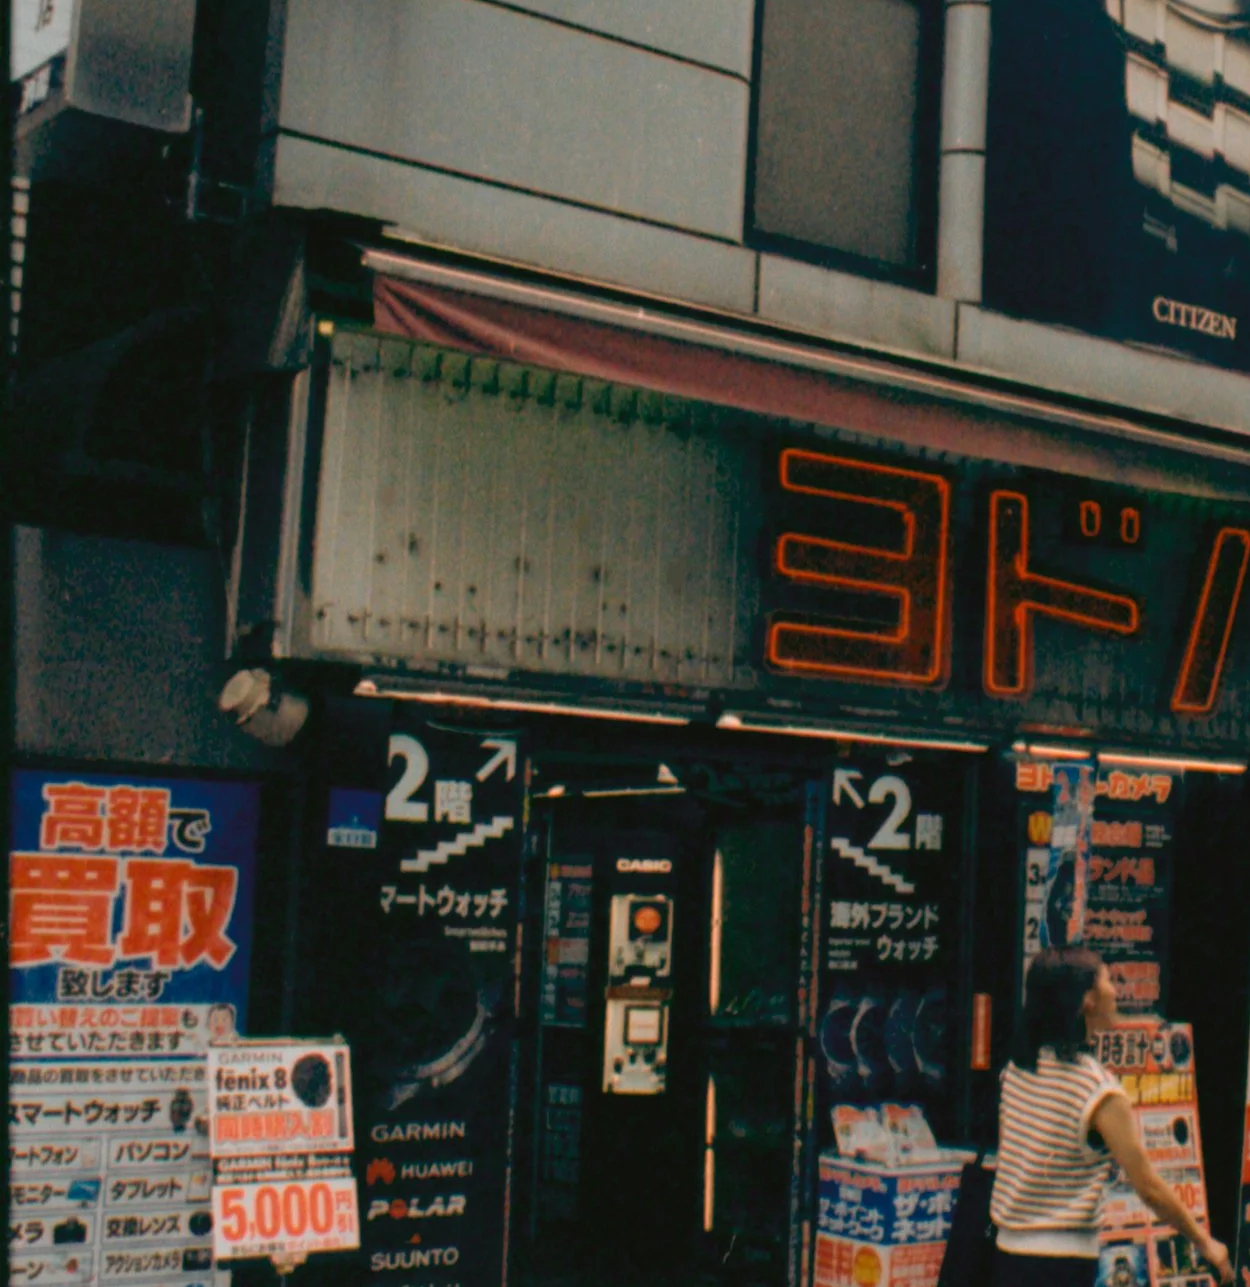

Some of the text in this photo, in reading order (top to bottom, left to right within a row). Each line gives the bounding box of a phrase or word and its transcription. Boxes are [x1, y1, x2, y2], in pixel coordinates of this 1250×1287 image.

[1152, 296, 1237, 340] CITIZEN
[384, 734, 472, 824] 2階
[40, 781, 212, 854] 高額で
[866, 776, 942, 850] 2階
[616, 857, 673, 873] CASIO
[9, 852, 239, 972] 買取
[876, 934, 940, 961] ウォッチ
[59, 966, 170, 1000] 致します
[274, 1067, 288, 1089] 8
[371, 1122, 466, 1143] GARMIN
[115, 1141, 191, 1162] パソコン
[401, 1161, 473, 1179] HUAWEI
[220, 1182, 335, 1242] 5,000
[367, 1195, 467, 1221] POLAR
[371, 1247, 459, 1271] SUUNTO
